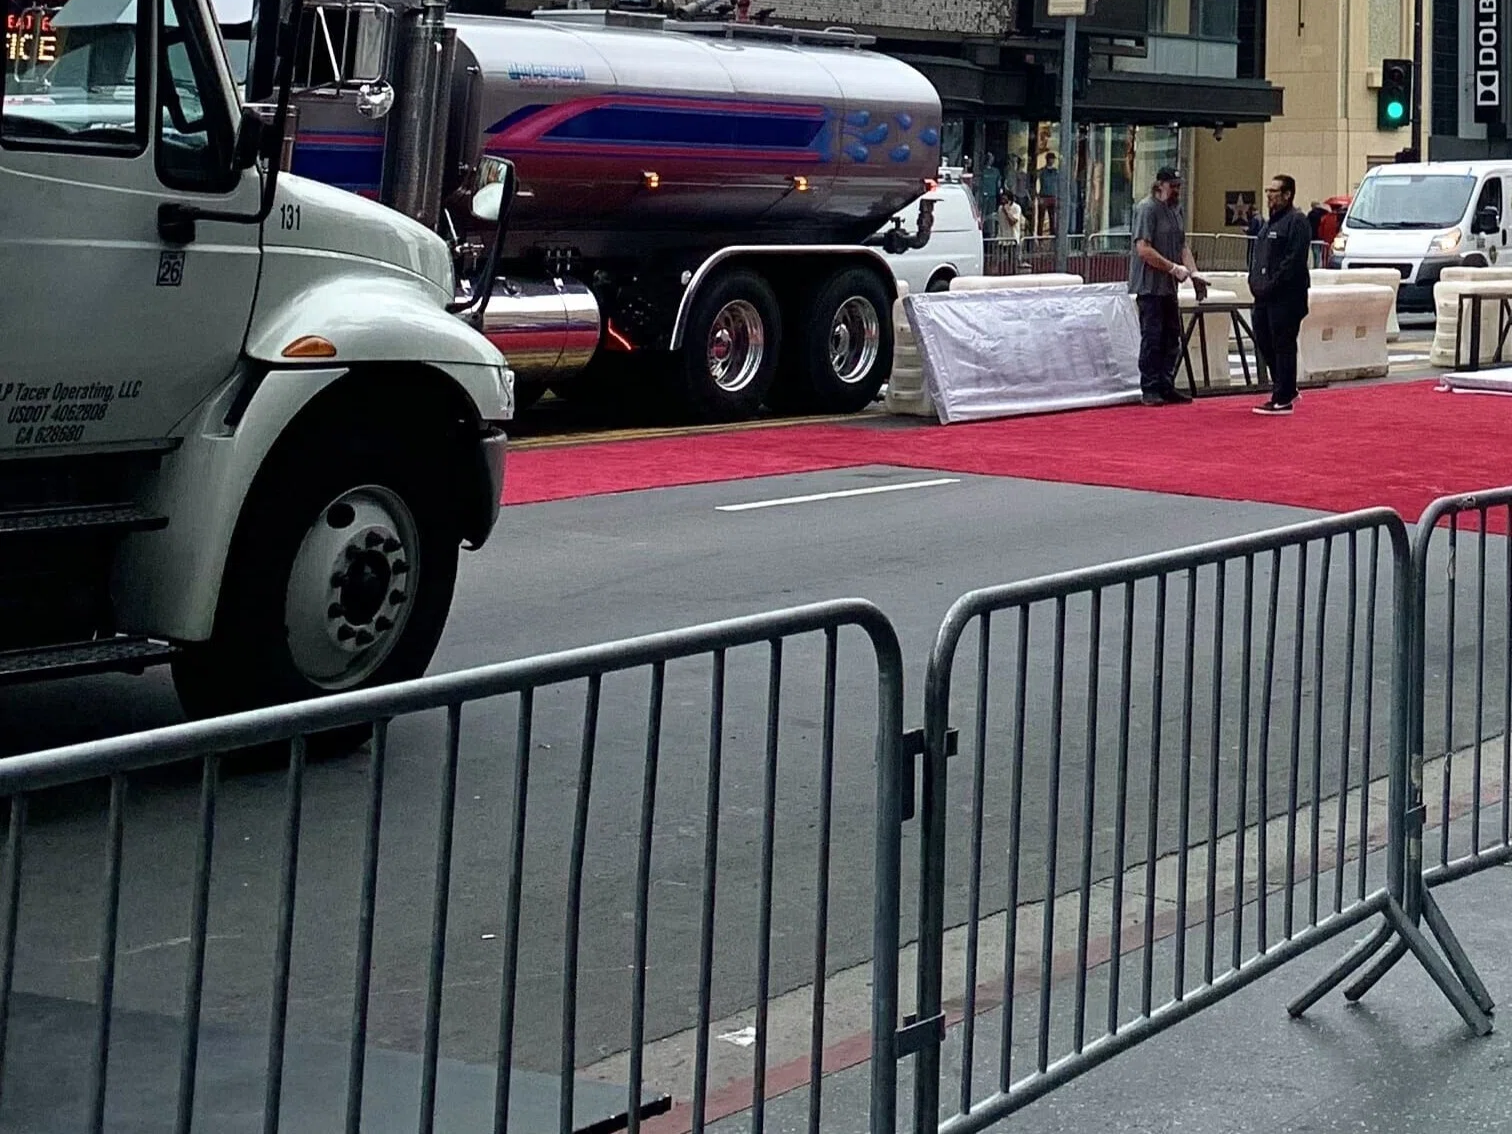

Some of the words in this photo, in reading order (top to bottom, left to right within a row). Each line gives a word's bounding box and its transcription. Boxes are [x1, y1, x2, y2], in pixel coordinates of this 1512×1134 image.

[281, 205, 300, 230] 131
[160, 261, 180, 282] 26
[52, 382, 114, 403] Operating,
[118, 380, 142, 398] LLC
[8, 405, 51, 423] USDOT
[16, 426, 34, 444] CA
